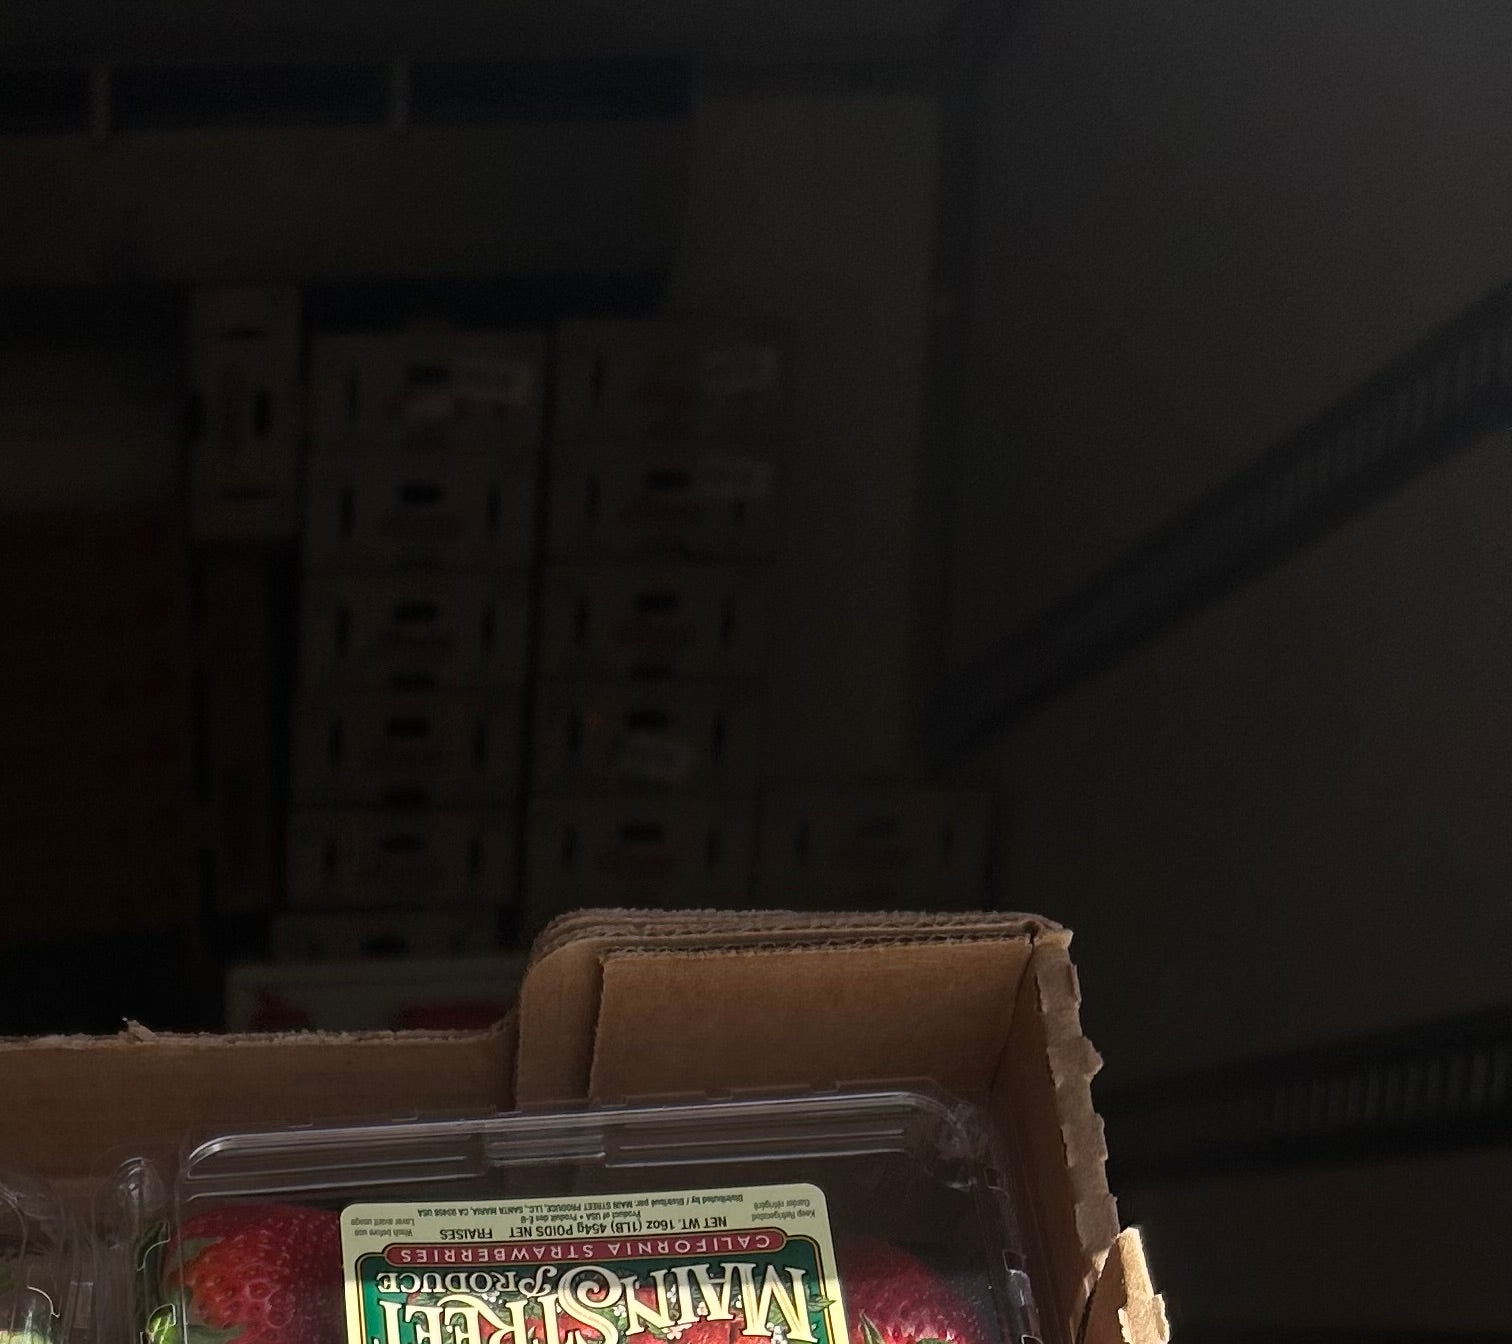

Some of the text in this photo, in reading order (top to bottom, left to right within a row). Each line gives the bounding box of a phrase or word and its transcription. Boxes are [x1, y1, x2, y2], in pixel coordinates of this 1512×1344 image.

[577, 1221, 606, 1234] 454g
[610, 1219, 641, 1233] (1LB)
[703, 1217, 727, 1228] NET
[439, 1228, 492, 1240] FRAISES
[509, 1226, 531, 1237] NET
[536, 1224, 572, 1236] POIDS
[401, 1235, 770, 1265] CALIFORNIA STRAWBERRIES
[376, 1265, 557, 1296] PRODUCE
